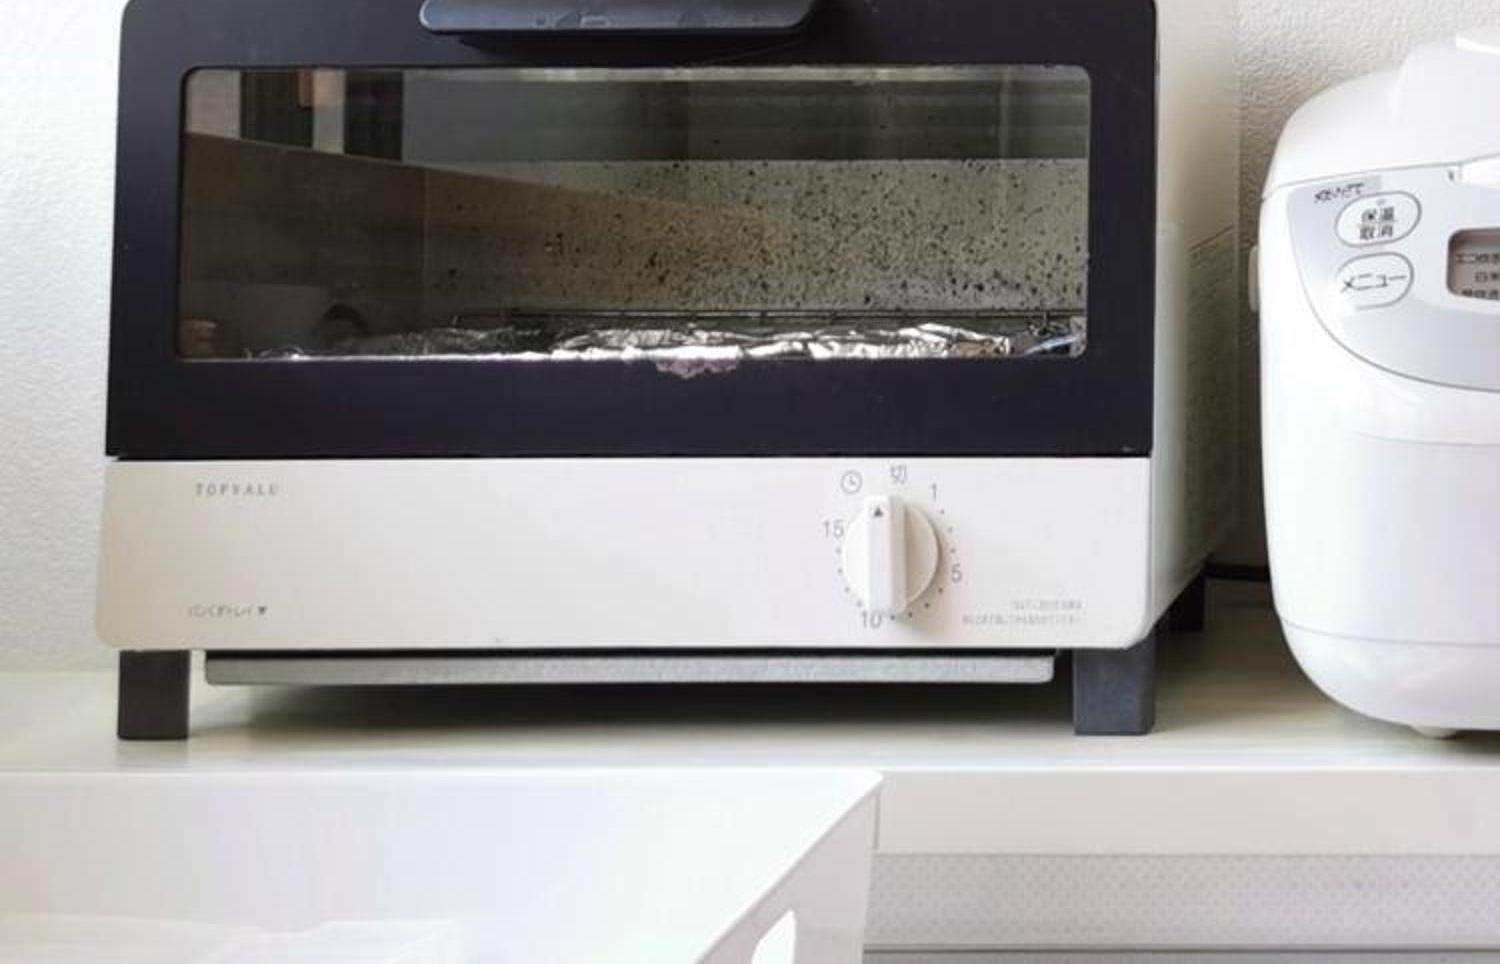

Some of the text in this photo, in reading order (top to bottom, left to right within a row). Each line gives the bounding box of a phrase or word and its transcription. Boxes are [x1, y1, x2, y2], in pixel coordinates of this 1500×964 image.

[1361, 206, 1395, 223] 保温
[1341, 273, 1407, 293] メニュー
[890, 464, 908, 485] 切
[822, 519, 845, 538] 15
[951, 563, 963, 583] 5
[861, 610, 882, 629] 10
